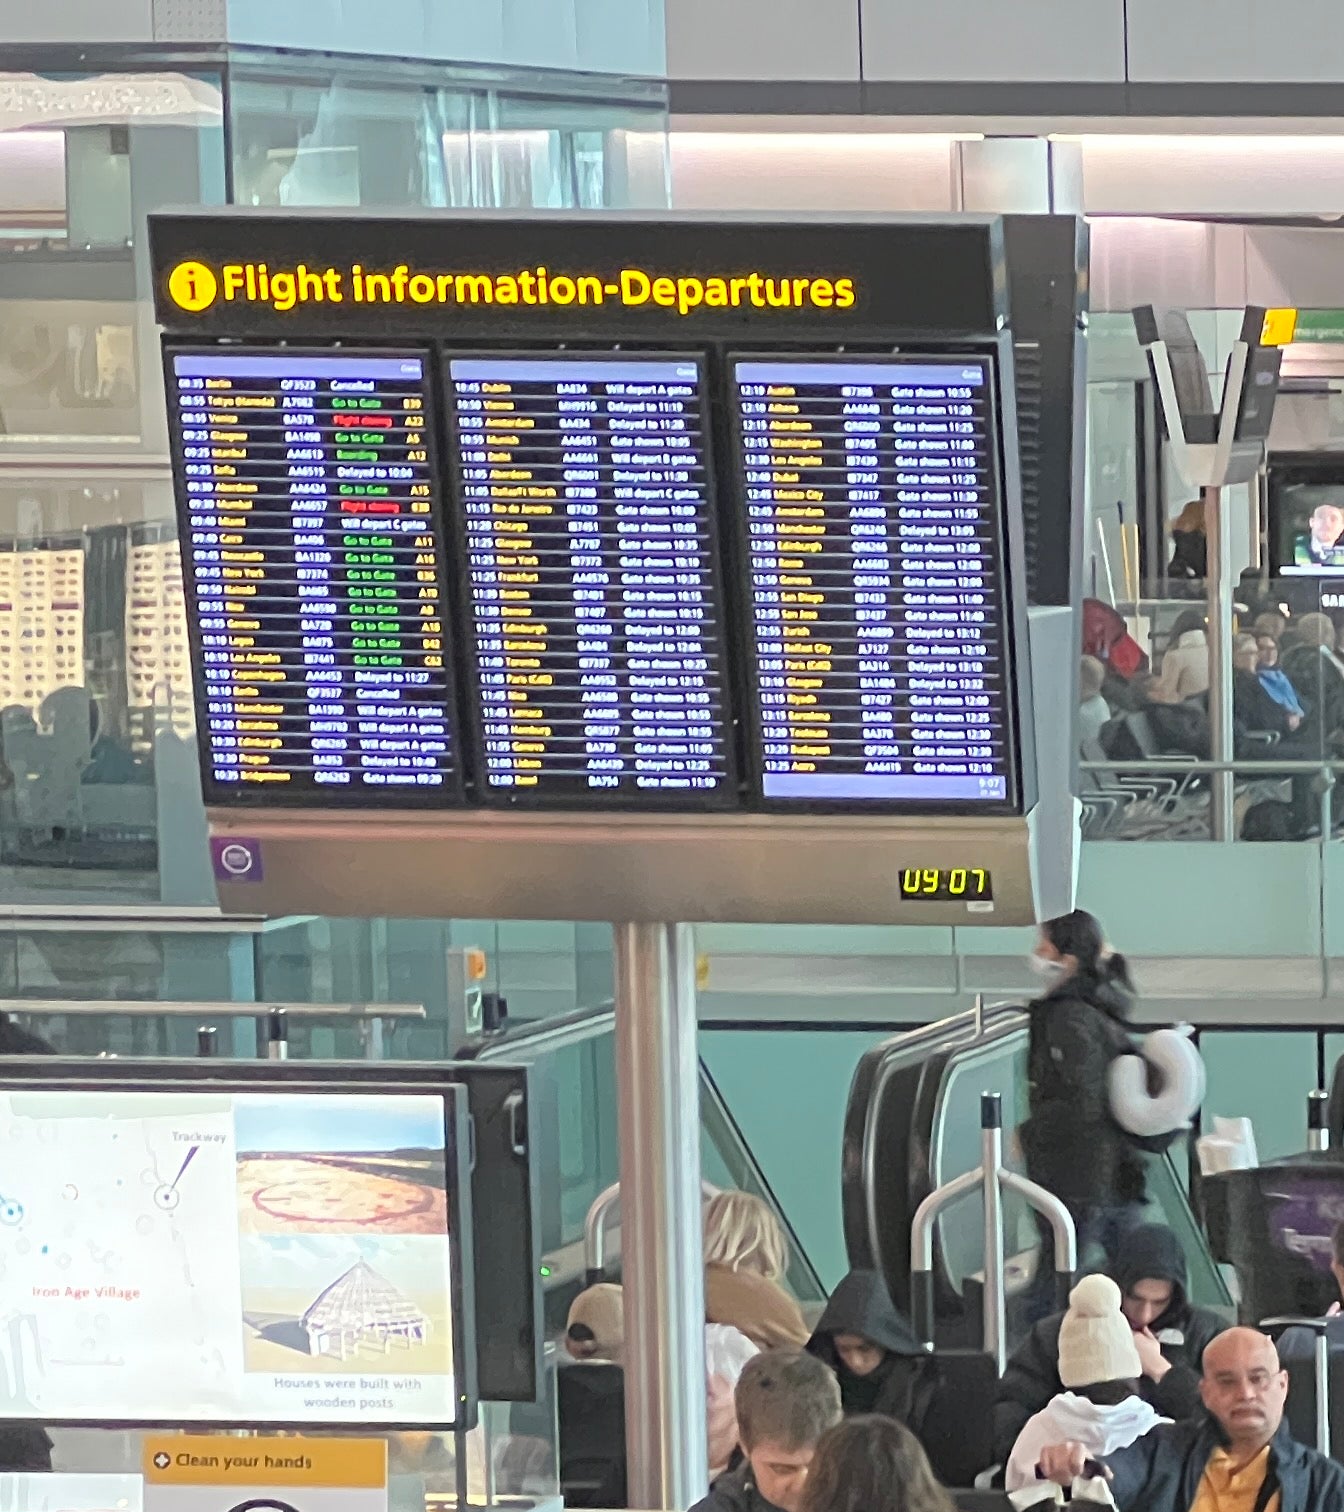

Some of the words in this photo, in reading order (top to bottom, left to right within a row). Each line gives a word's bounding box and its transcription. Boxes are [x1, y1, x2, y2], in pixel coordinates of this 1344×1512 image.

[222, 265, 342, 311] Flight
[172, 1131, 227, 1144] Trackway
[32, 1287, 60, 1297] Iron
[65, 1287, 90, 1300] Age
[95, 1287, 140, 1301] Village
[274, 1378, 320, 1390] Houses
[325, 1380, 356, 1390] were
[360, 1378, 388, 1390] built
[393, 1379, 421, 1390] with
[304, 1398, 355, 1408] wooden
[359, 1398, 394, 1410] posts
[176, 1453, 218, 1466] Clean
[224, 1456, 258, 1470] your
[264, 1455, 312, 1469] hands
